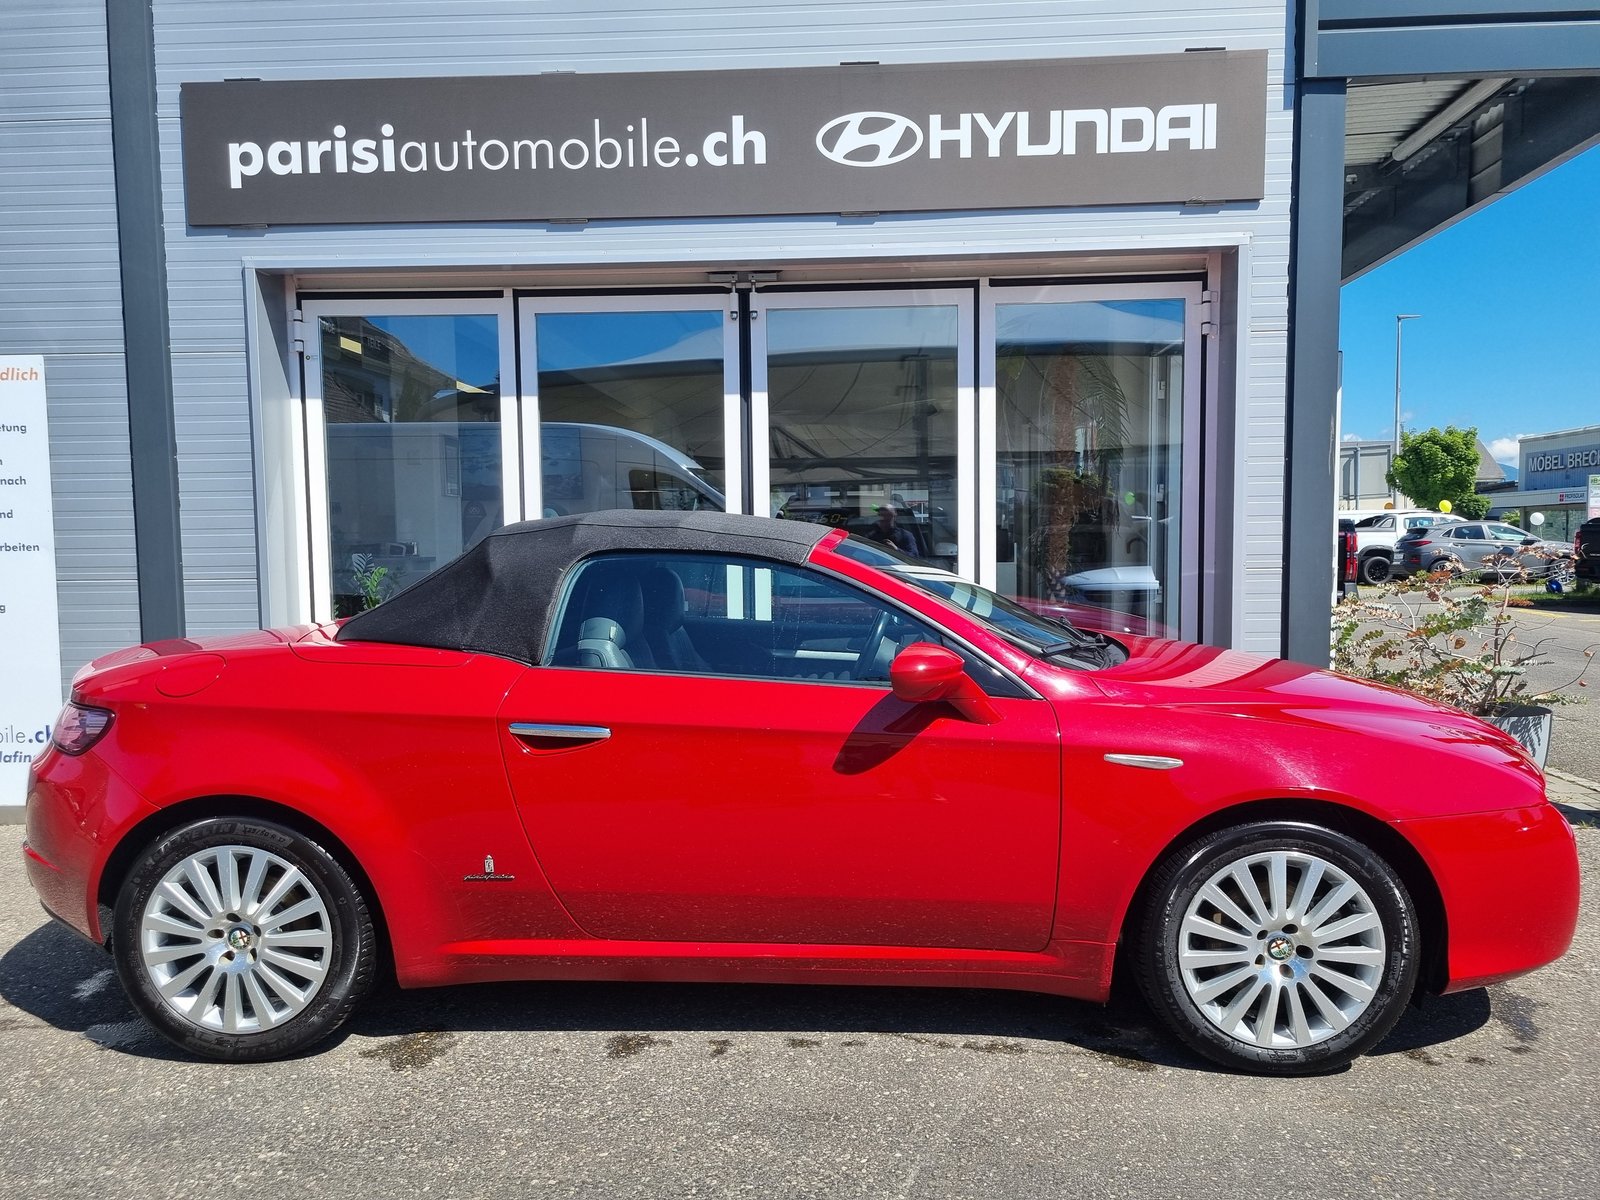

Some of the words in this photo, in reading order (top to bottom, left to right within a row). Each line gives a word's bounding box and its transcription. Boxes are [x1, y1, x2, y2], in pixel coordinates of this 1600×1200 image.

[929, 103, 1217, 159] HYUNDAI
[228, 115, 766, 189] parisiautomobile.ch
[0, 475, 26, 486] nach
[1528, 453, 1565, 472] MÖBEL
